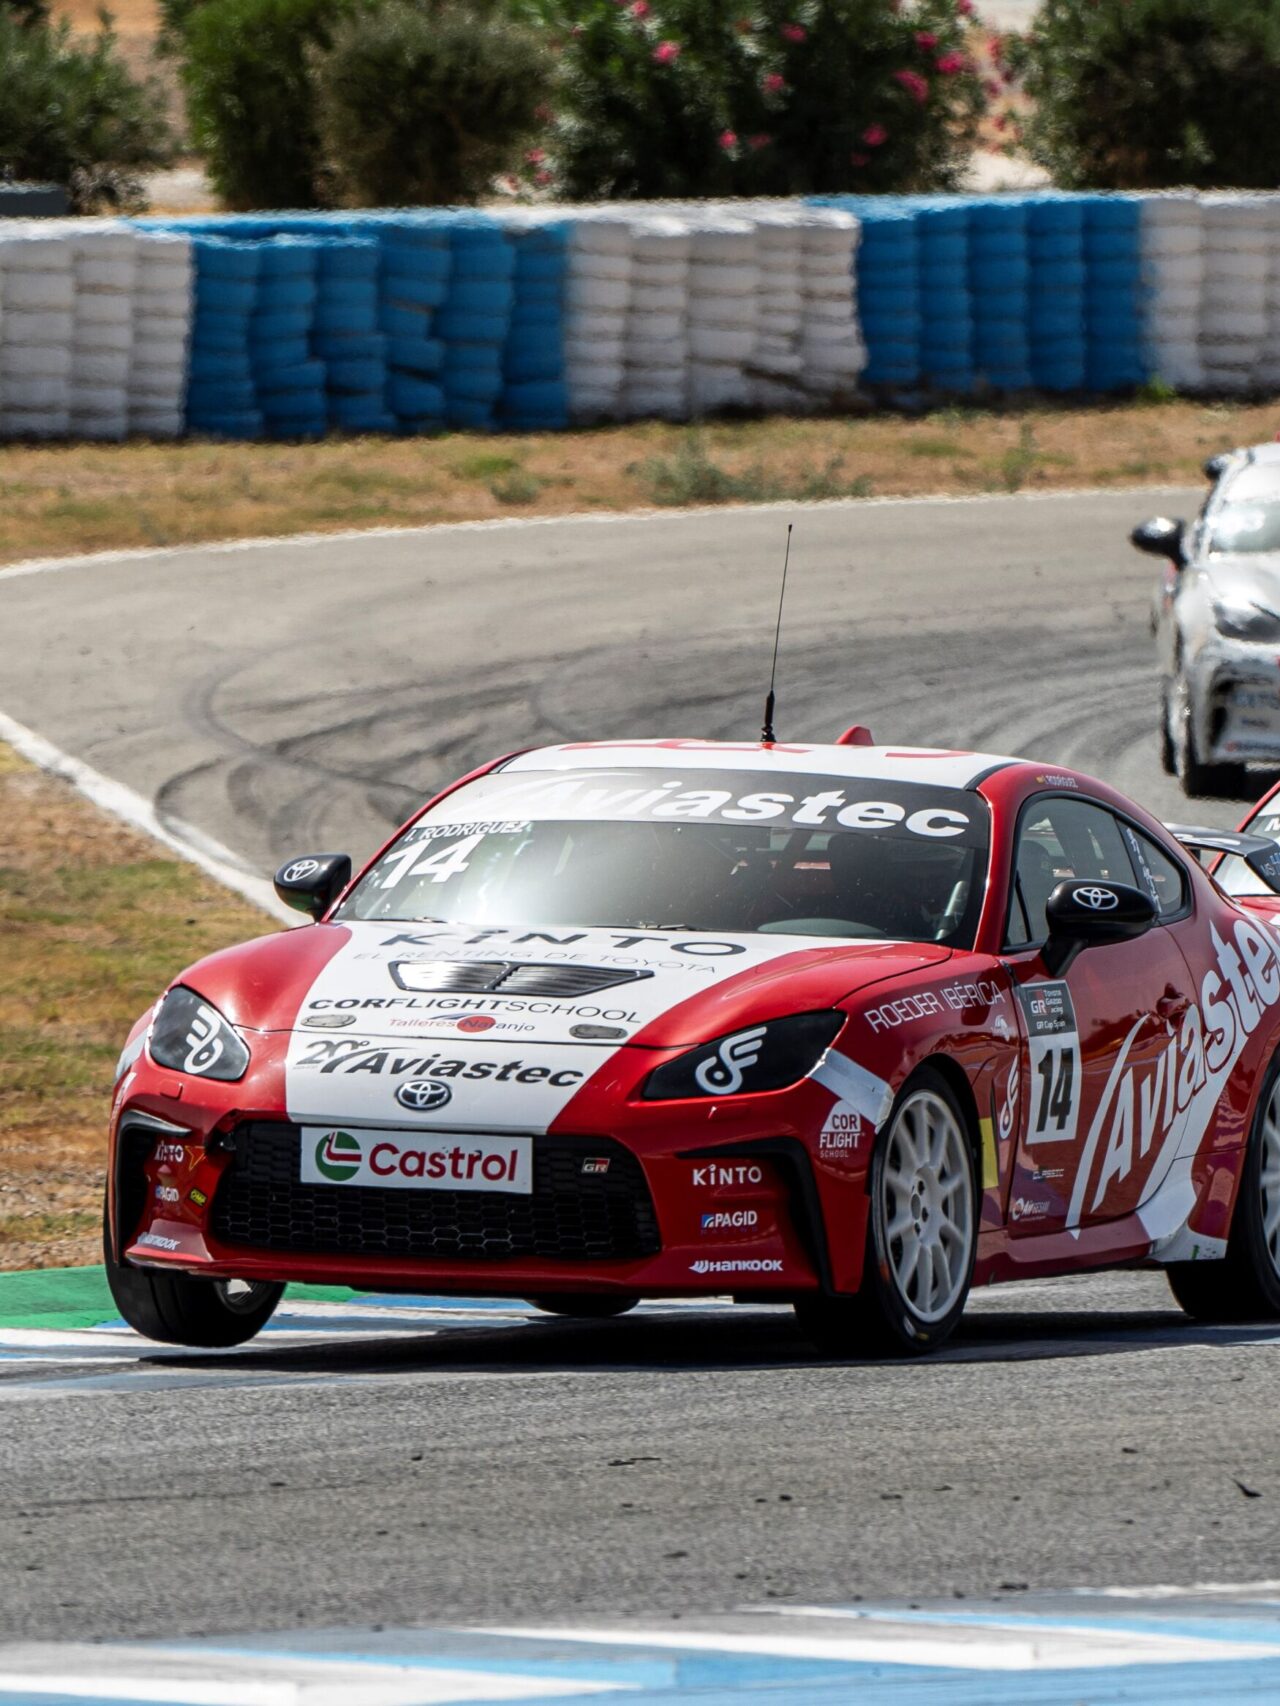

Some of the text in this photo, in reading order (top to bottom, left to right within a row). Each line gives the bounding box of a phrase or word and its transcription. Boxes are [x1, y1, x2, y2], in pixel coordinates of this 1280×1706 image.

[512, 773, 970, 838] Aviastec
[380, 834, 486, 889] 14
[544, 950, 586, 961] DE
[598, 954, 717, 974] TOYOTA
[864, 980, 1006, 1034] ROEDER IBÉRICA
[389, 1016, 537, 1033] Talleres Naranjo
[343, 1051, 584, 1088] Aviastec
[1036, 1046, 1075, 1132] 14
[832, 1113, 858, 1131] COR
[819, 1131, 860, 1149] FLIGHT
[369, 1141, 520, 1182] Castrol
[819, 1149, 849, 1158] SCHOOL
[581, 1163, 609, 1173] GR
[714, 1210, 758, 1228] PAGID
